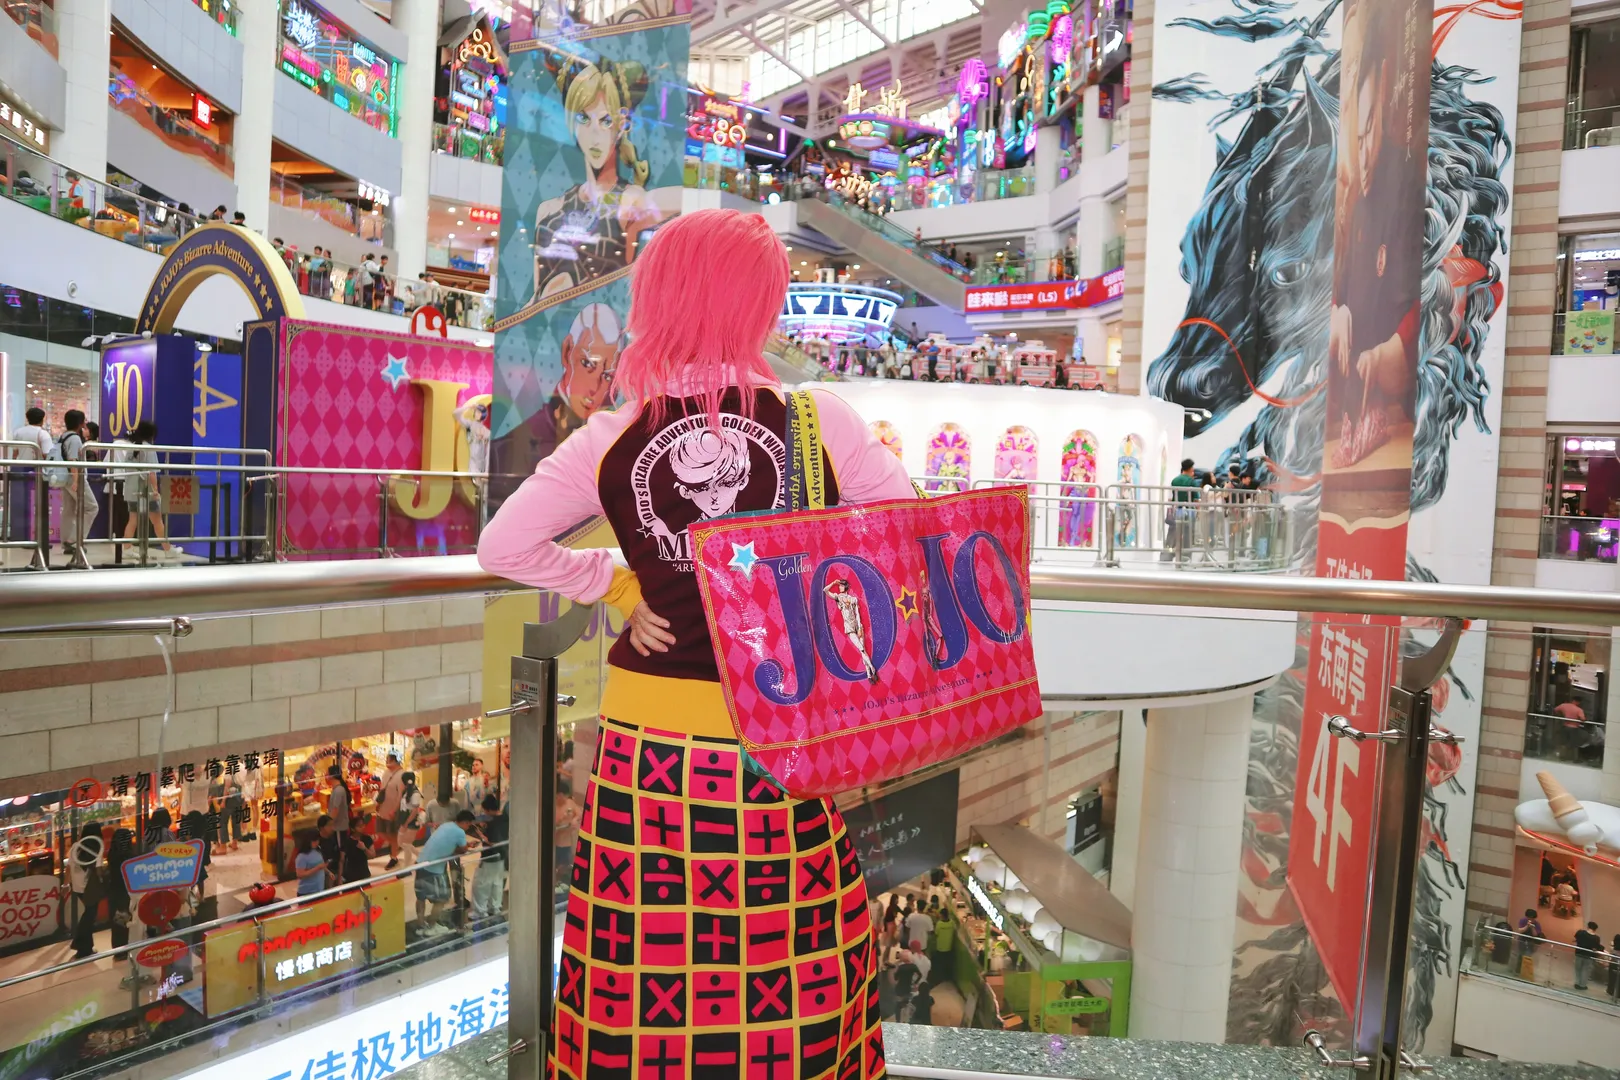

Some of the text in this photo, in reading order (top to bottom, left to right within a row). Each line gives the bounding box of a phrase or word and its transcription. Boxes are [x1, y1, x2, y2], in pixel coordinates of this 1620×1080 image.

[159, 241, 254, 296] JOJO's Bizarre Adventure
[109, 362, 143, 437] JO
[658, 416, 711, 450] ADVENTUR
[721, 416, 766, 440] GOLDEN
[636, 446, 661, 490] BIZARRE
[807, 432, 822, 505] Adventure
[636, 491, 656, 523] JOJO'S
[778, 558, 813, 581] Golden
[1318, 618, 1368, 716] 东南亭
[862, 697, 895, 711] JOJO's
[1305, 712, 1361, 893] 4F
[149, 868, 180, 883] Shop
[275, 940, 353, 982] 慢慢商店
[266, 981, 510, 1080] 佳极地海洋
